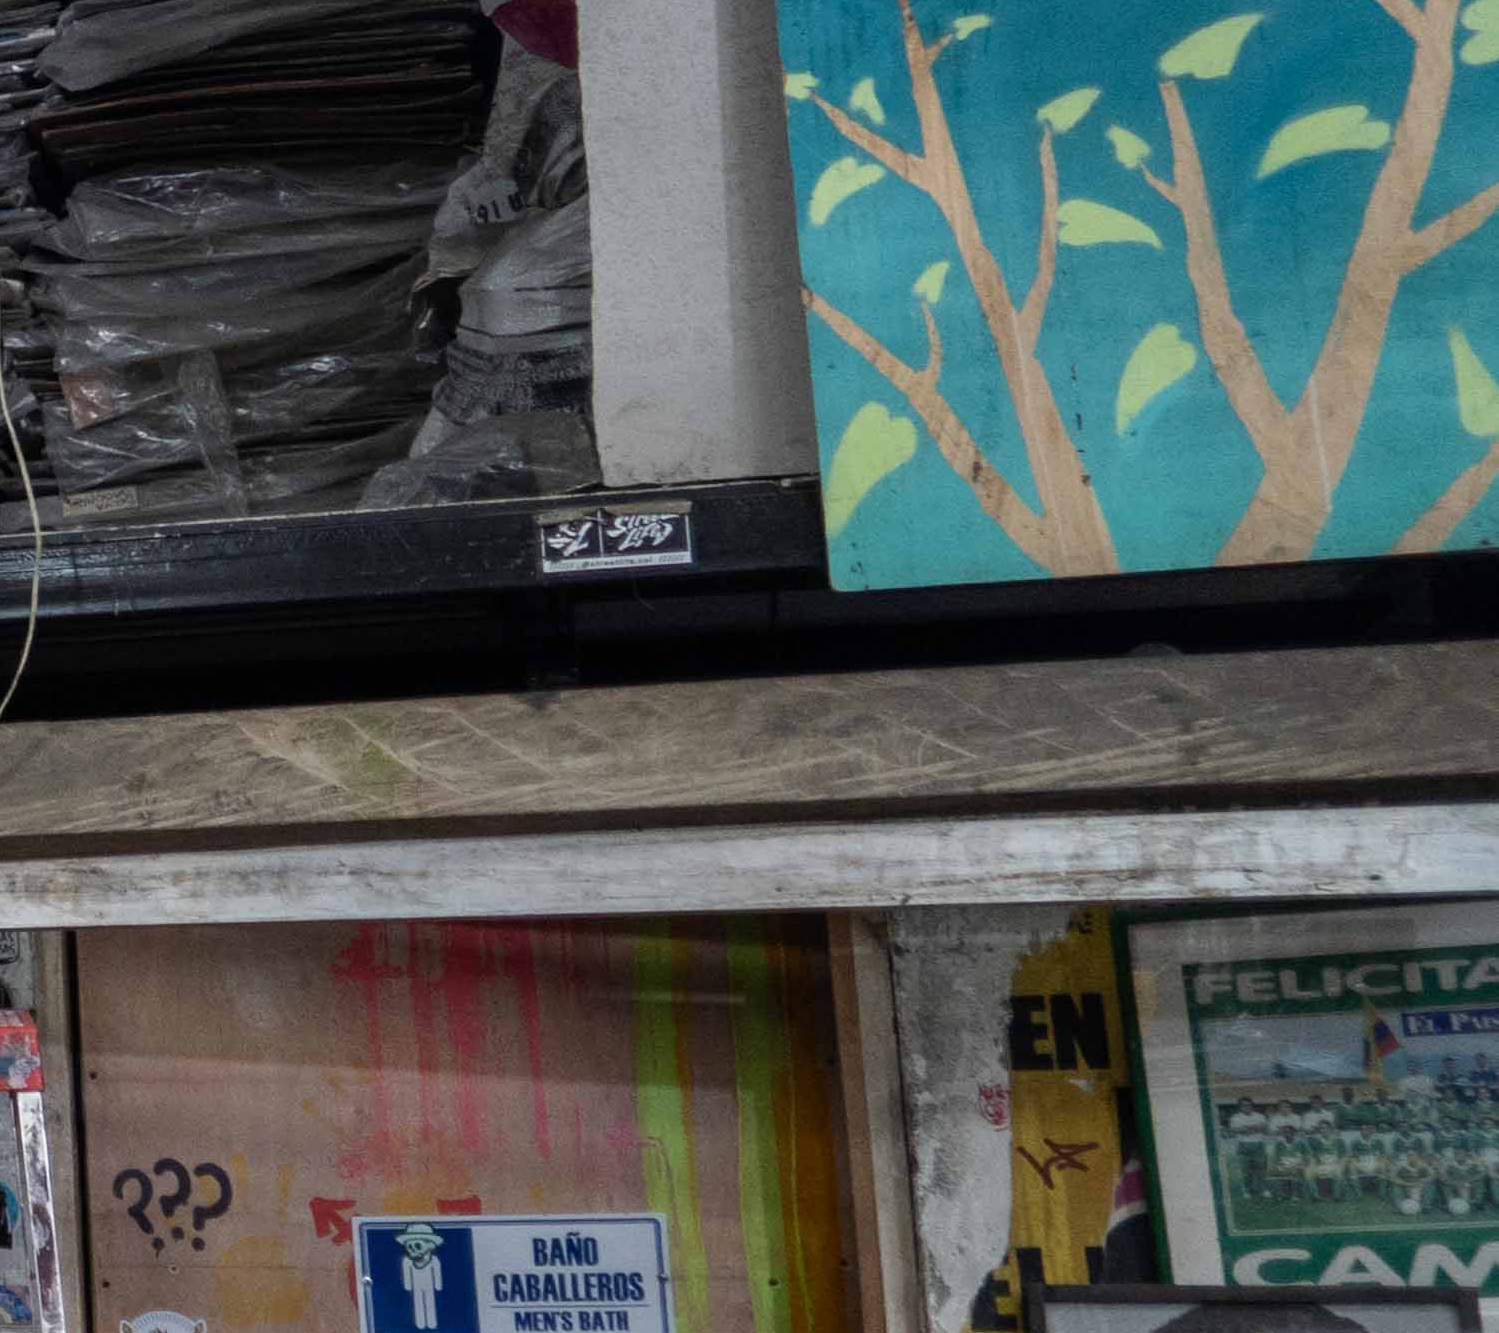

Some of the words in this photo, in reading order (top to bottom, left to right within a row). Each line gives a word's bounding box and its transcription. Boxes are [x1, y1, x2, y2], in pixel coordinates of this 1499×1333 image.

[532, 1231, 600, 1268] BAÑO
[492, 1271, 646, 1304] CABALLEROS
[513, 1310, 575, 1333] MEN'S
[579, 1309, 630, 1333] BATH
